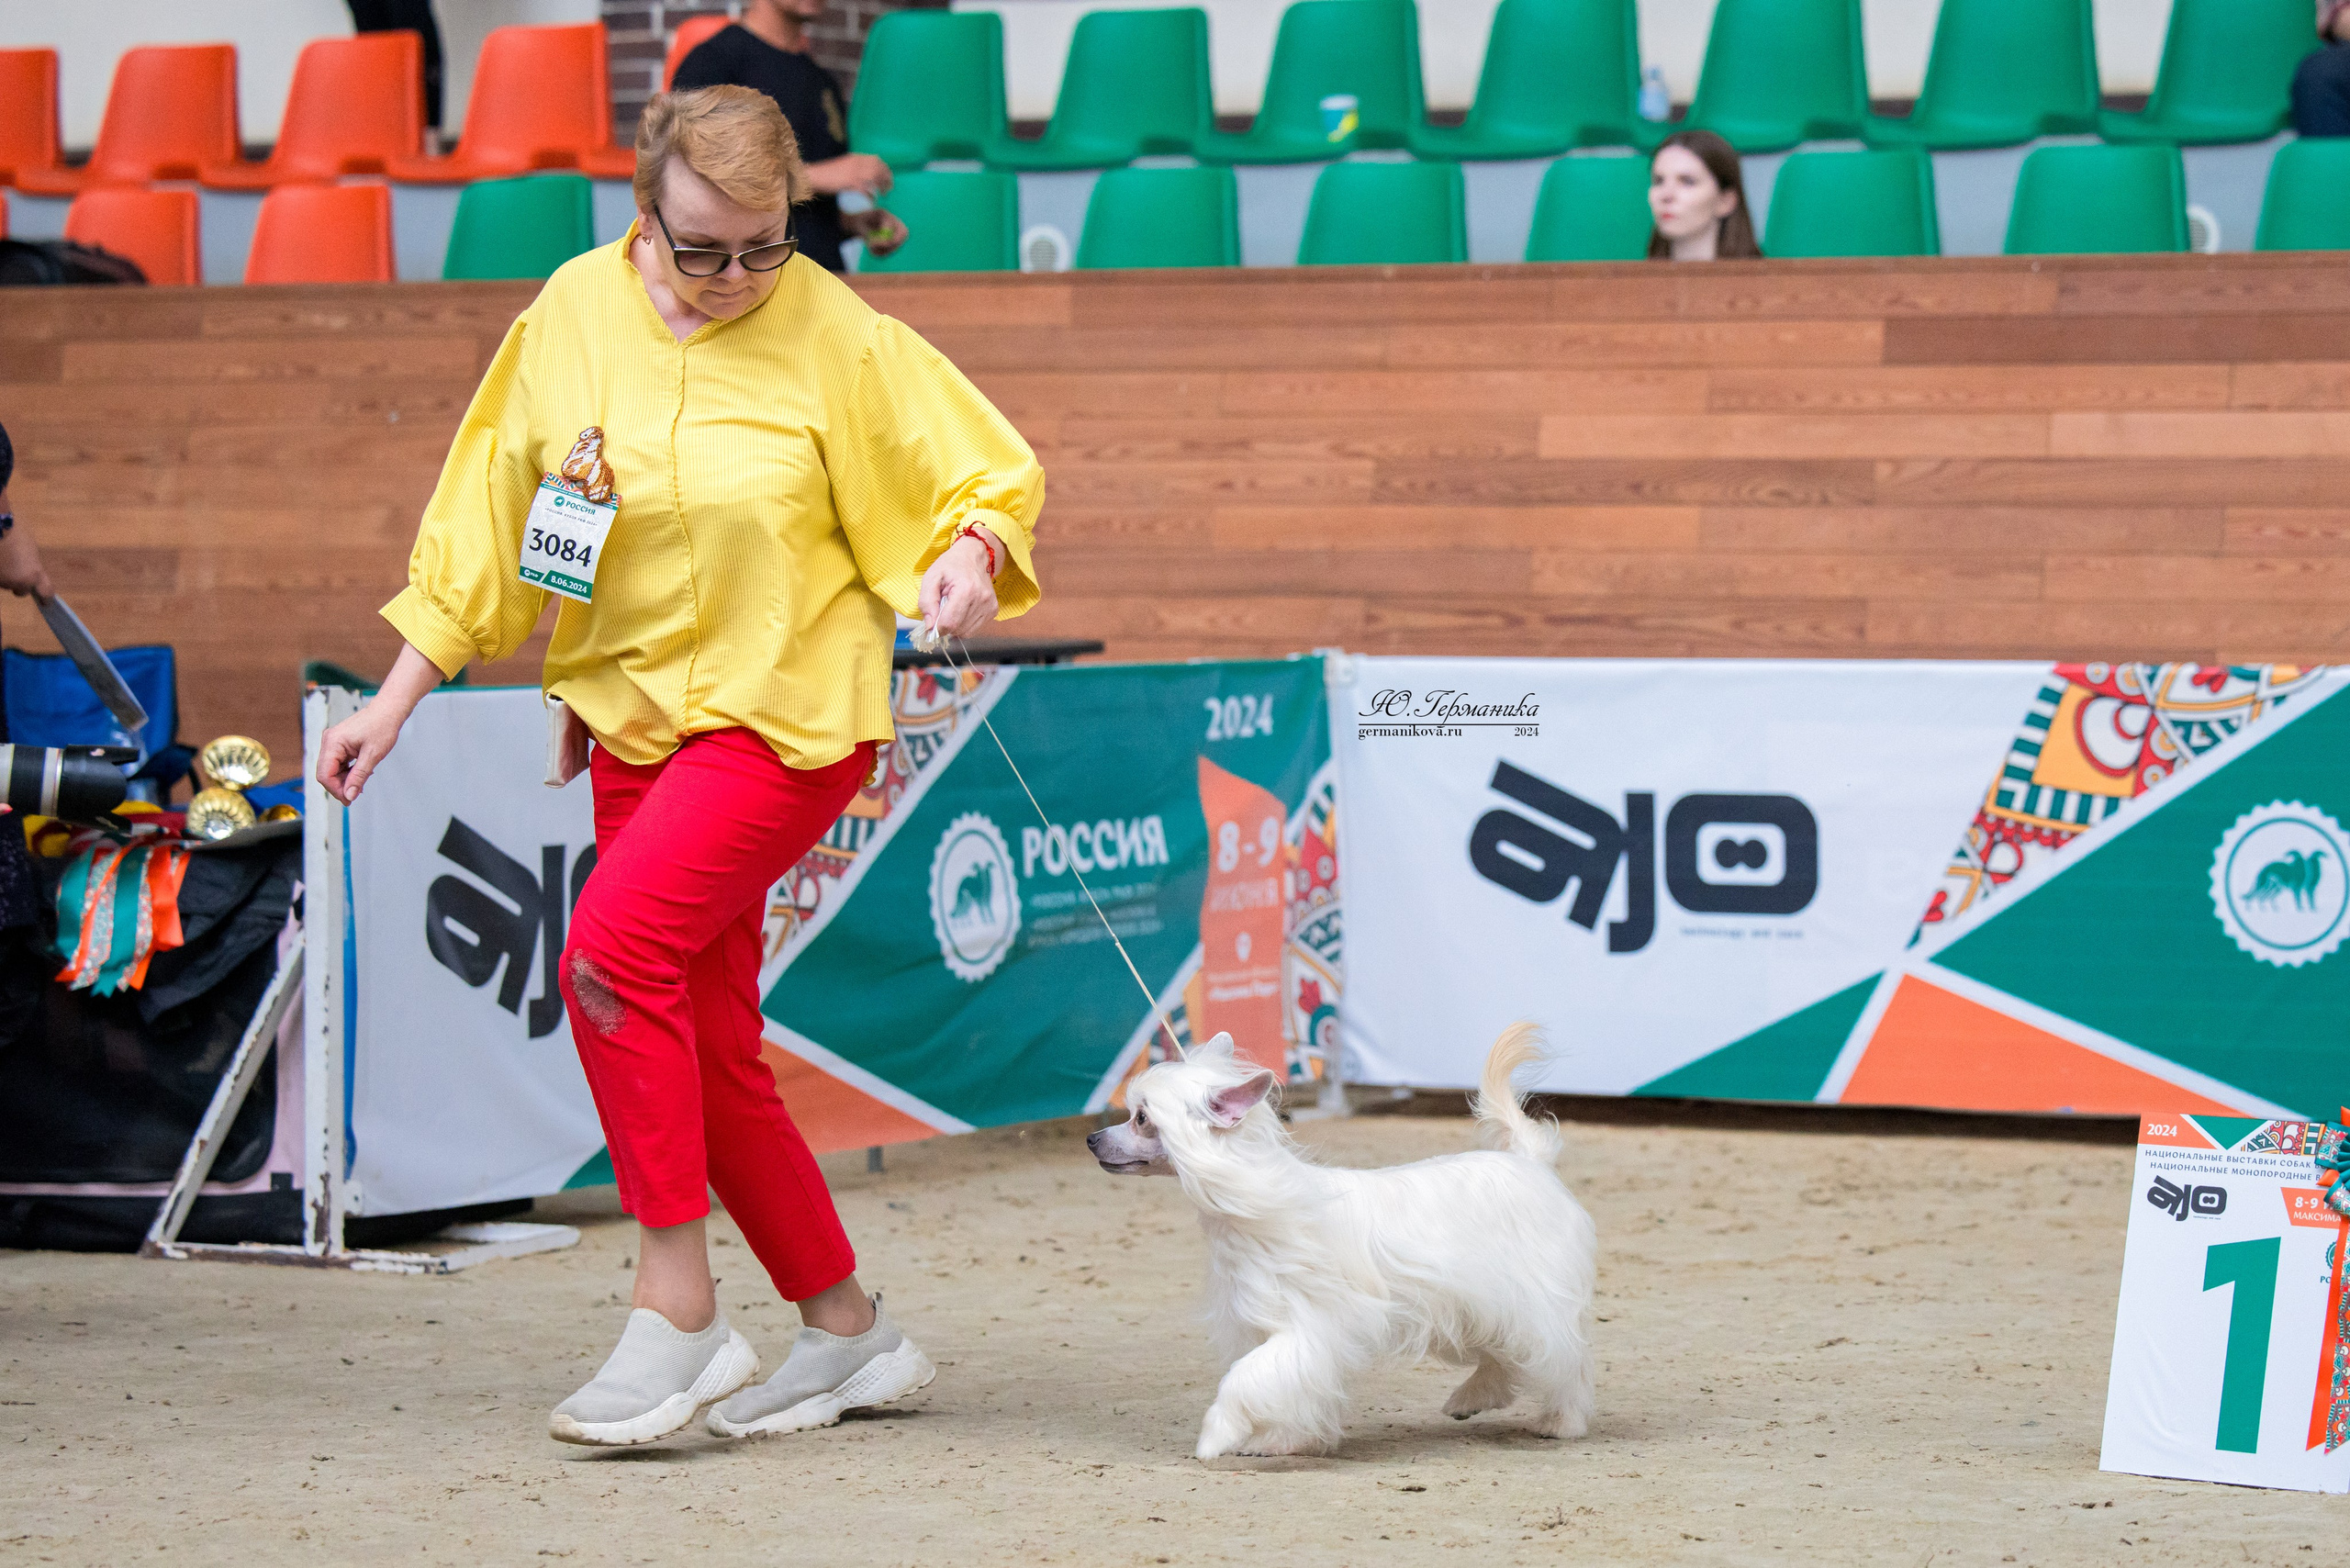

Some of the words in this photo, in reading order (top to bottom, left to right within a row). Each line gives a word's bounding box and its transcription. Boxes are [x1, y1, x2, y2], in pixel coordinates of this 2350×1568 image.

[565, 500, 596, 515] РОССИЯ
[529, 527, 592, 567] 3084
[551, 575, 588, 594] 8.06.2024
[1204, 694, 1273, 741] 2024
[1021, 813, 1169, 879] РОССИЯ
[1217, 816, 1280, 872] 8-9
[2146, 1124, 2177, 1137] 2024
[2145, 1149, 2223, 1162] НАЦИОНАЛЬНЫЕ
[2226, 1155, 2277, 1167] ВЫСТАВКИ
[2280, 1159, 2311, 1170] СОБАК
[2150, 1162, 2229, 1175] НАЦИОНАЛЬНЫЕ
[2231, 1168, 2311, 1181] МОНОПОРОДНЫЕ
[2295, 1196, 2319, 1209] 8-9
[2202, 1236, 2281, 1455] 1
